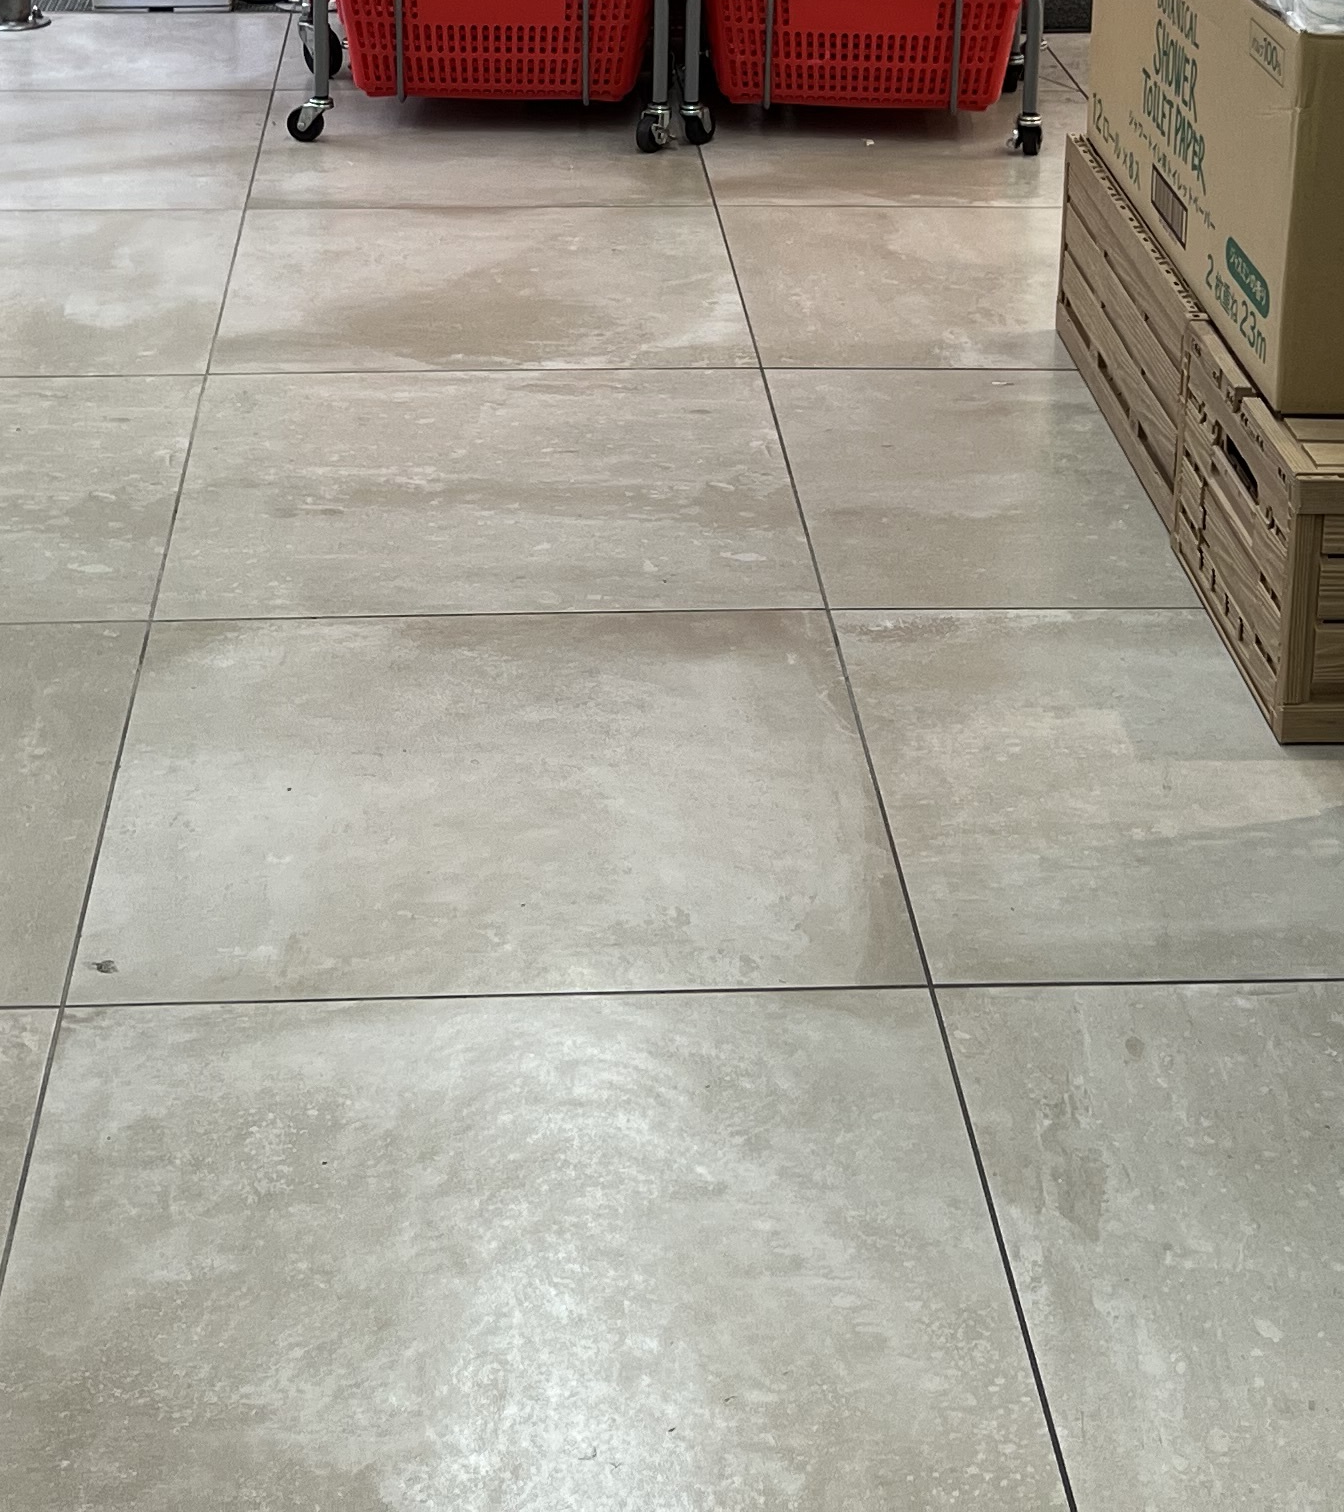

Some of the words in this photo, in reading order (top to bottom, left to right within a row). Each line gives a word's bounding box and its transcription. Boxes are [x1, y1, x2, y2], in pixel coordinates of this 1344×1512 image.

[1152, 18, 1199, 124] SHOWER
[1141, 66, 1175, 148] TOILET
[1173, 102, 1208, 197] PAPER
[1238, 298, 1269, 366] 23m
